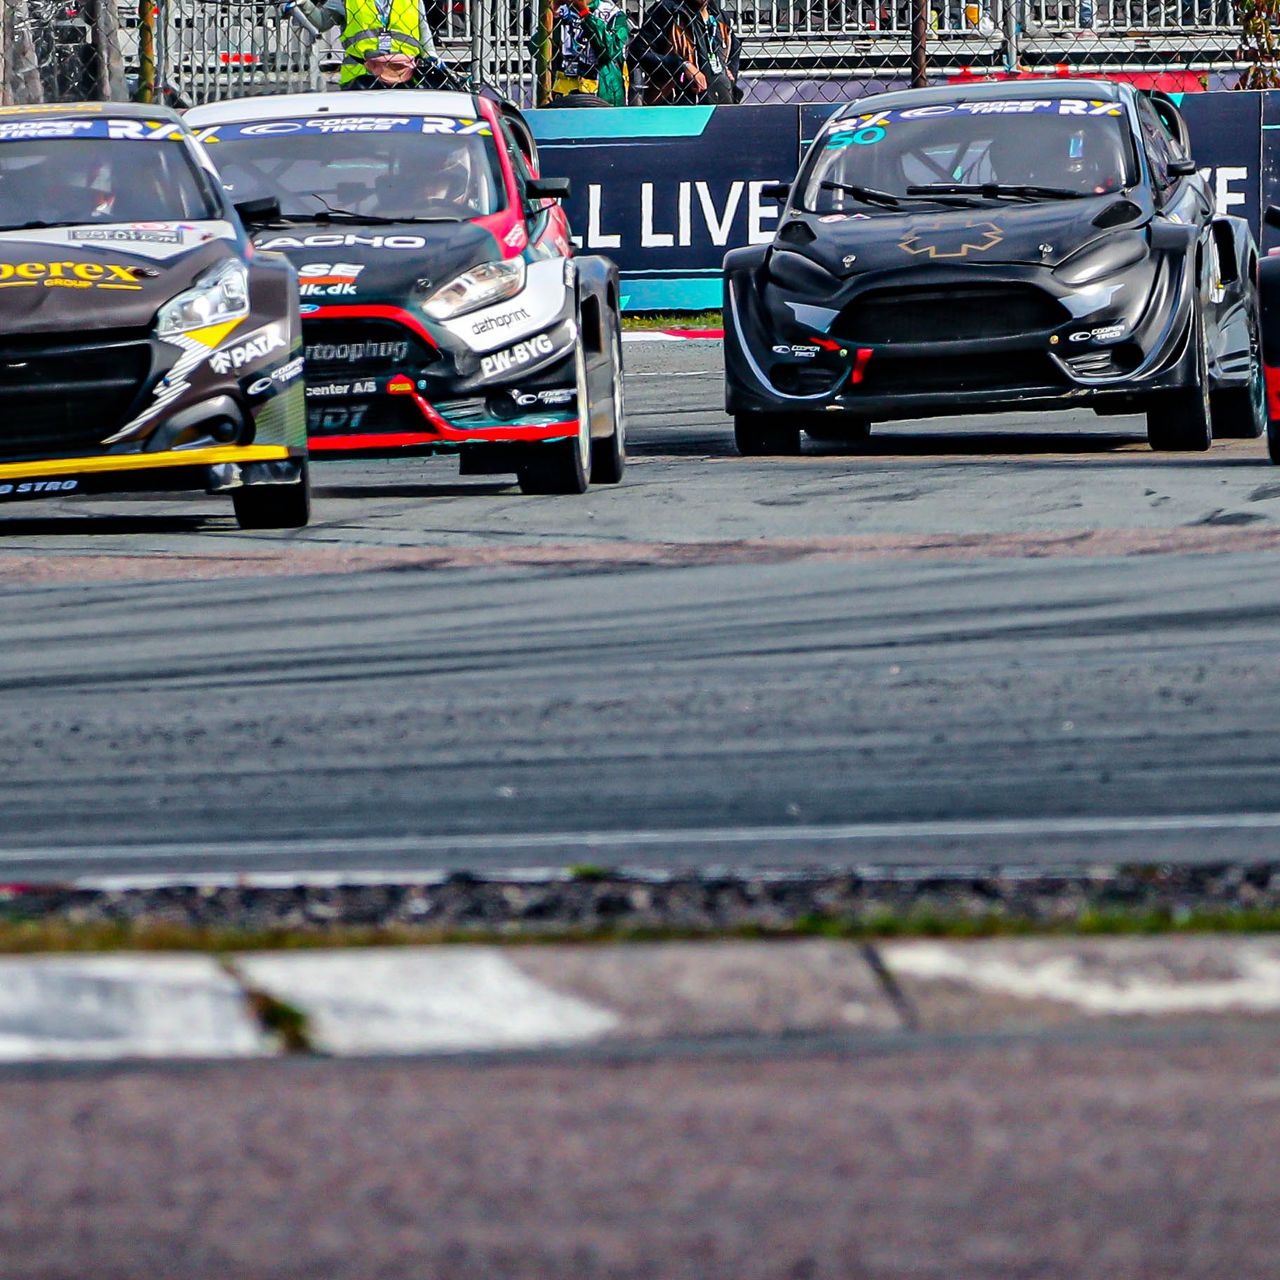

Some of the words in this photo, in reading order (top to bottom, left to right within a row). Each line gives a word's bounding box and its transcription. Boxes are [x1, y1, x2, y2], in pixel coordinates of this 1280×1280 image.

[1059, 99, 1122, 116] RX
[107, 119, 185, 141] RX
[305, 118, 410, 128] COOPER
[318, 123, 392, 133] TIRES
[422, 117, 492, 136] RX
[828, 110, 892, 134] RX
[826, 126, 887, 150] 50
[641, 180, 780, 247] LIVE
[43, 278, 93, 289] GROUP
[1091, 325, 1125, 336] COOPER
[231, 331, 286, 369] PATA
[480, 333, 554, 379] PW-BYG
[16, 479, 78, 493] STRO
